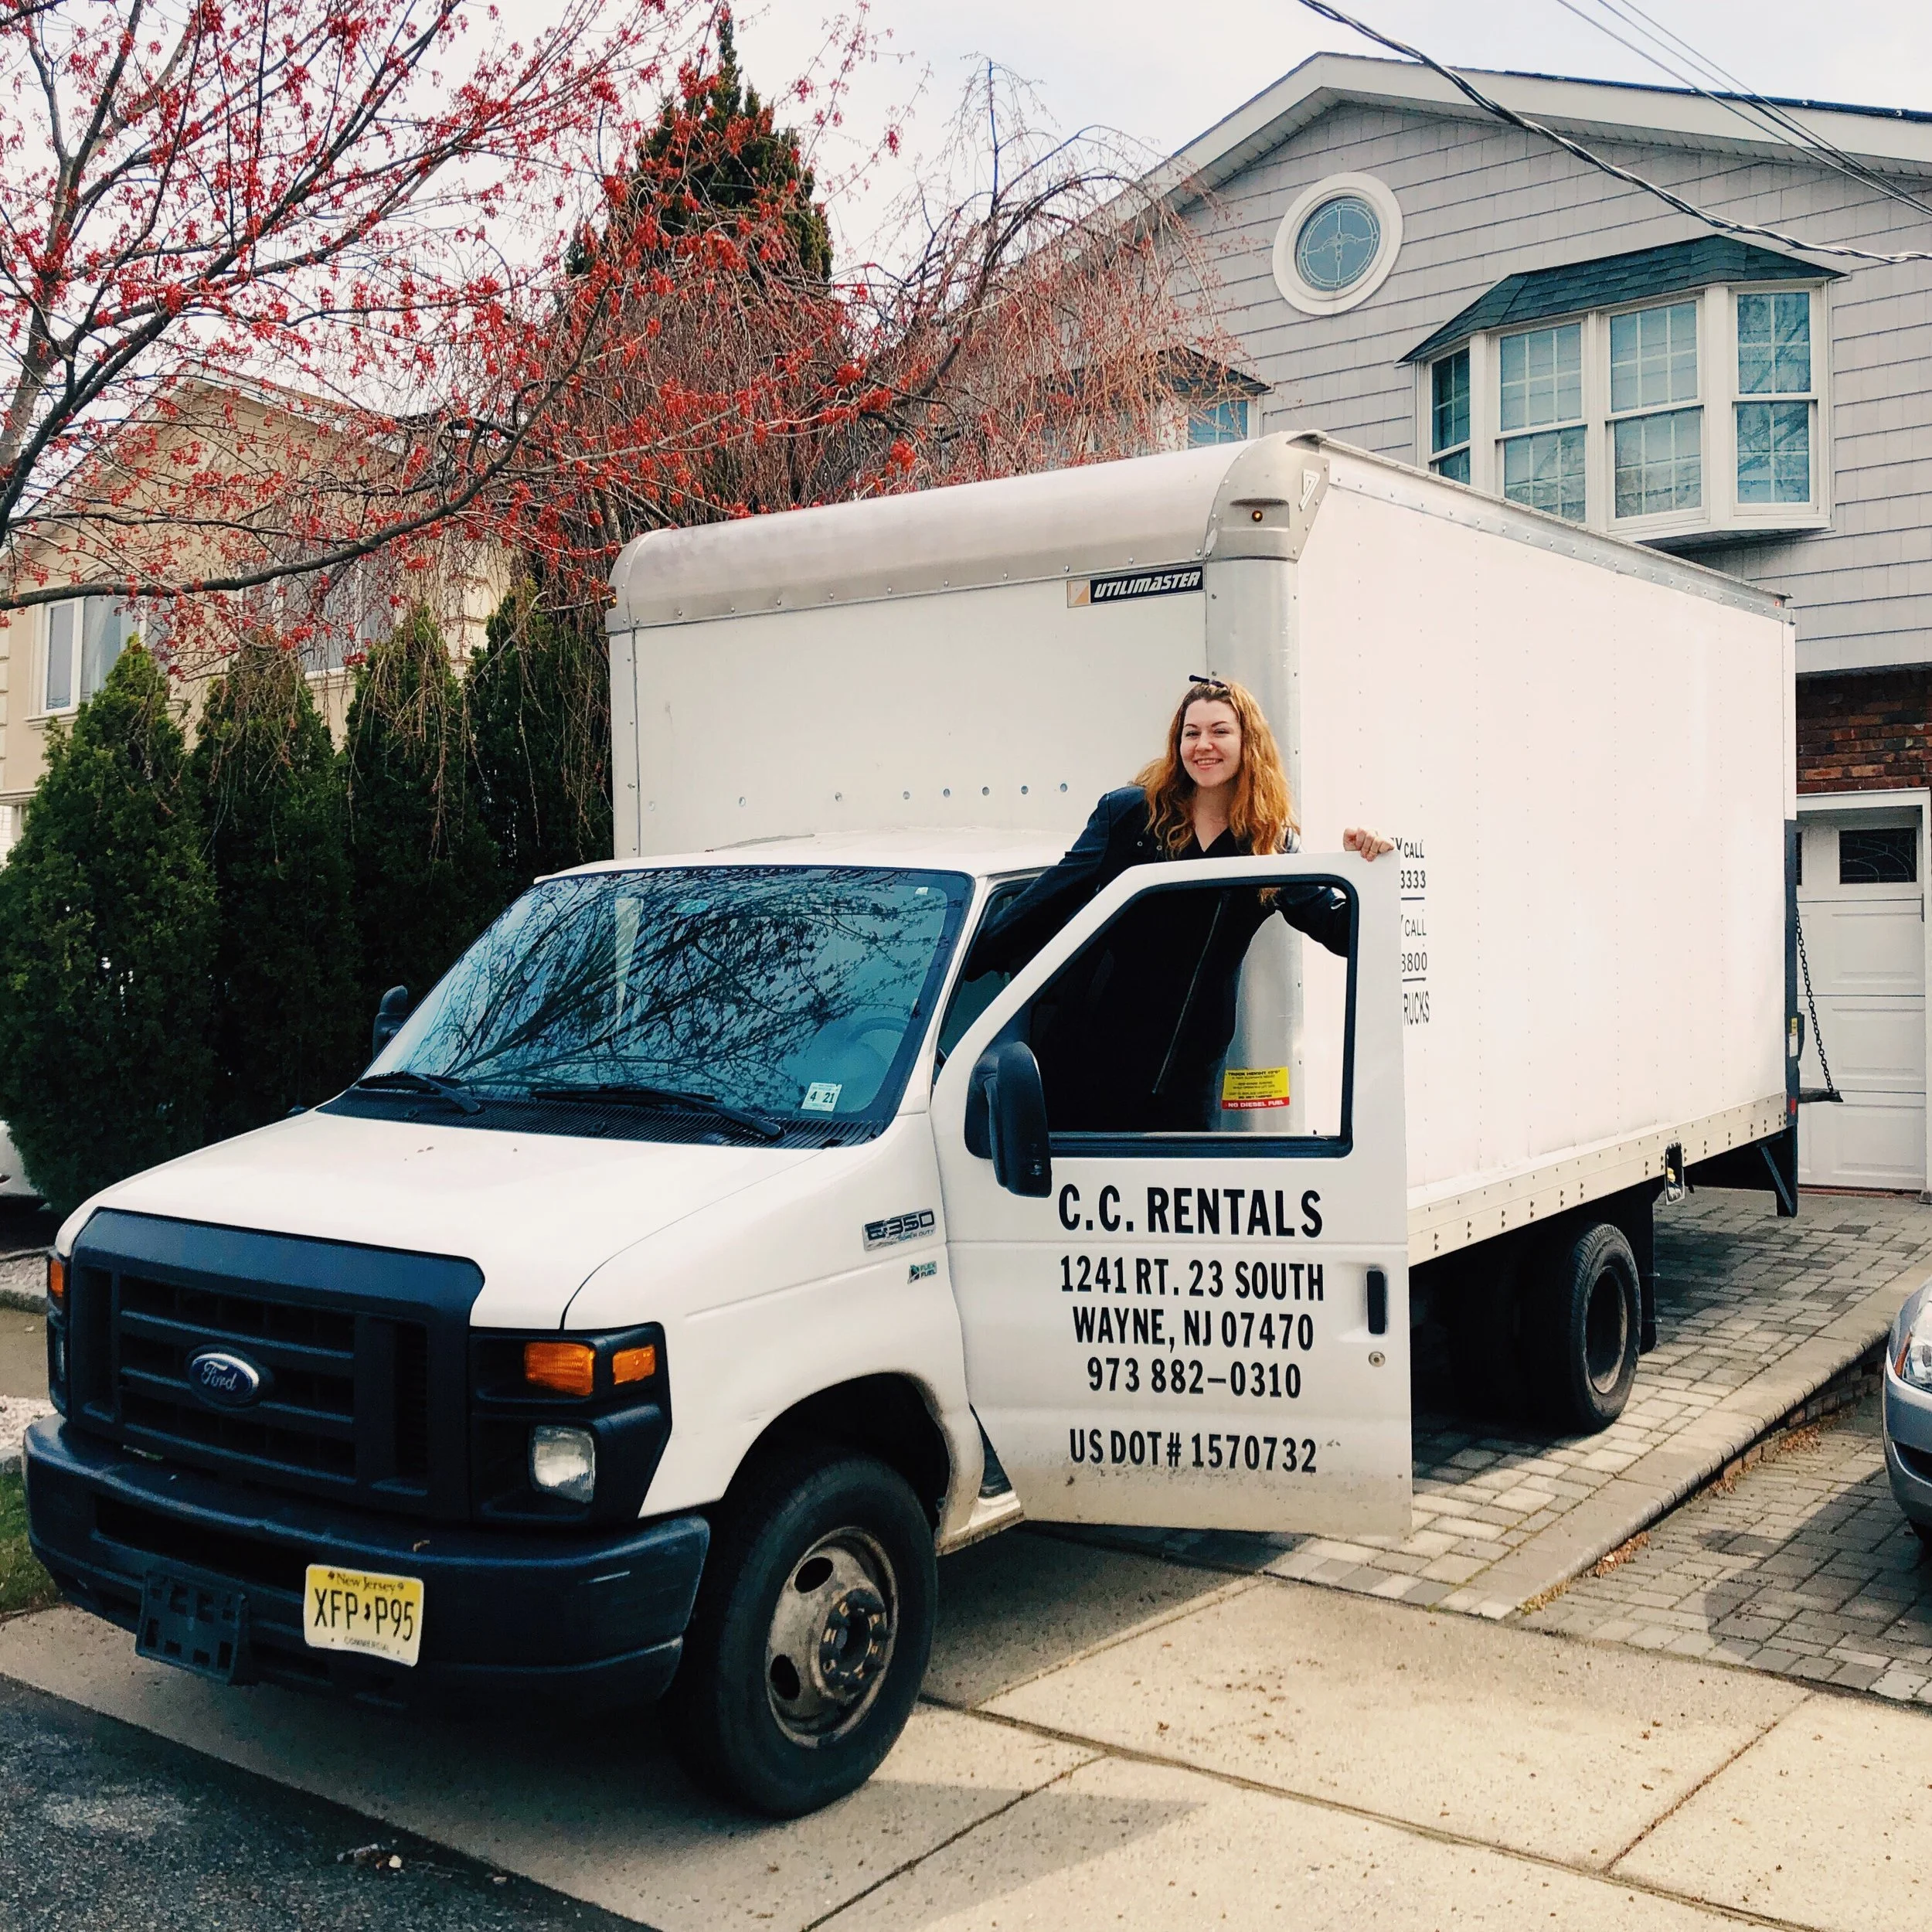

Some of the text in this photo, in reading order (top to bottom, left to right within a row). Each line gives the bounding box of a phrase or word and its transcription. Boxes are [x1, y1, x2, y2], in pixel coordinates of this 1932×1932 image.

[1094, 571, 1201, 598] UTILIMASTER
[1404, 841, 1424, 859] CALL
[1404, 919, 1427, 937] CALL
[1403, 992, 1430, 1026] RUCKS
[810, 1091, 835, 1104] 4 21
[1059, 1183, 1323, 1238] C.C. RENTALS
[1060, 1255, 1324, 1301] 1241 RT. 23 SOUTH
[1073, 1306, 1314, 1353] WAYNE, NJ 07470
[201, 1361, 237, 1391] Ford
[1087, 1356, 1301, 1399] 973 882-0310
[1191, 1432, 1317, 1474] 1570732
[336, 1573, 396, 1595] New Jersey
